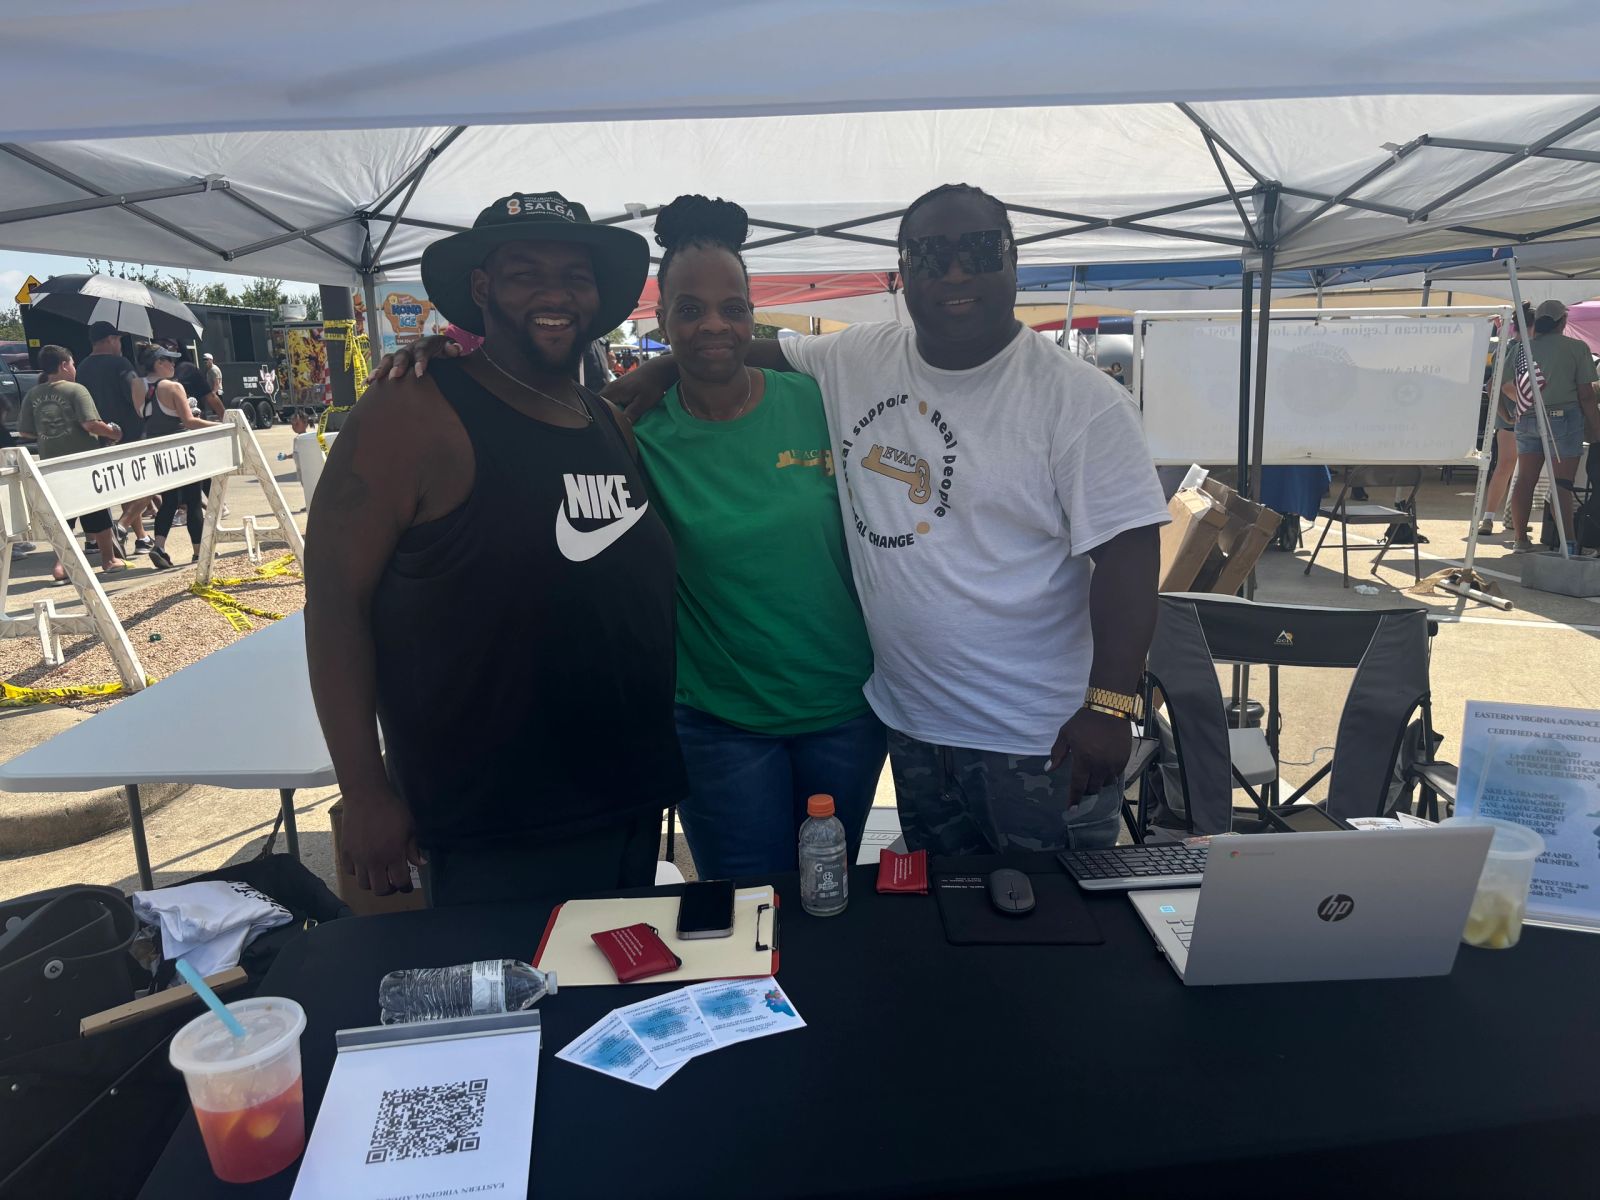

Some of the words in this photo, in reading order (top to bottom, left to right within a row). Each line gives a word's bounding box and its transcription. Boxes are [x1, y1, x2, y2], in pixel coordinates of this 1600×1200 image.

[524, 202, 576, 220] SALGA
[931, 410, 958, 450] Real
[882, 446, 917, 467] EVAC
[131, 456, 147, 482] OF
[933, 454, 957, 518] people
[563, 473, 636, 519] NIKE
[868, 531, 915, 549] CHANGE
[1474, 711, 1514, 720] EASTERN
[1515, 714, 1556, 724] VIRGINIA
[1557, 719, 1600, 728] ADVANCE
[1487, 727, 1533, 737] CERTIFIED
[814, 863, 823, 877] G
[1320, 894, 1351, 922] hp
[415, 1188, 459, 1200] VIRGINIA
[460, 1182, 505, 1194] EASTERN
